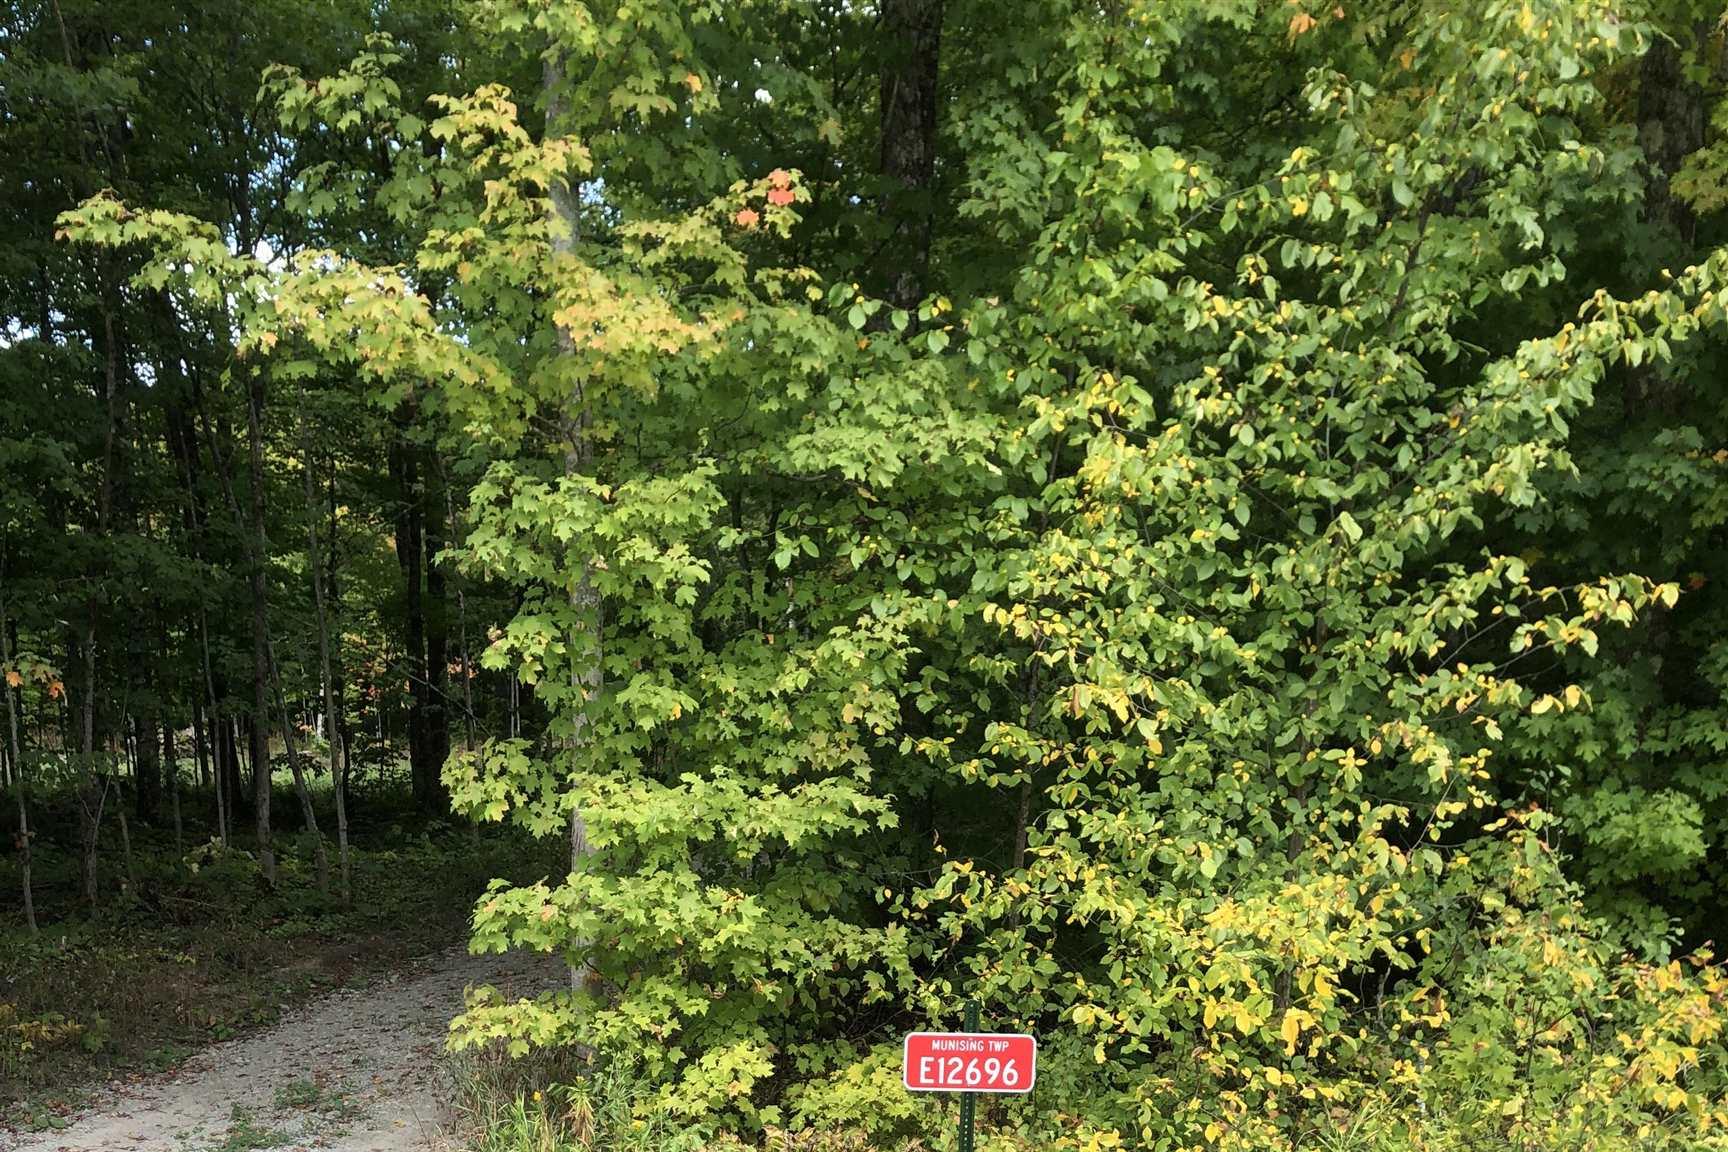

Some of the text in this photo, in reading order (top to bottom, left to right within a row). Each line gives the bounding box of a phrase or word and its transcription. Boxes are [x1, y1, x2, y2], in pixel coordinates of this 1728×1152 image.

[931, 1040, 1009, 1052] MUNISING TWP
[919, 1056, 1019, 1086] E12696
